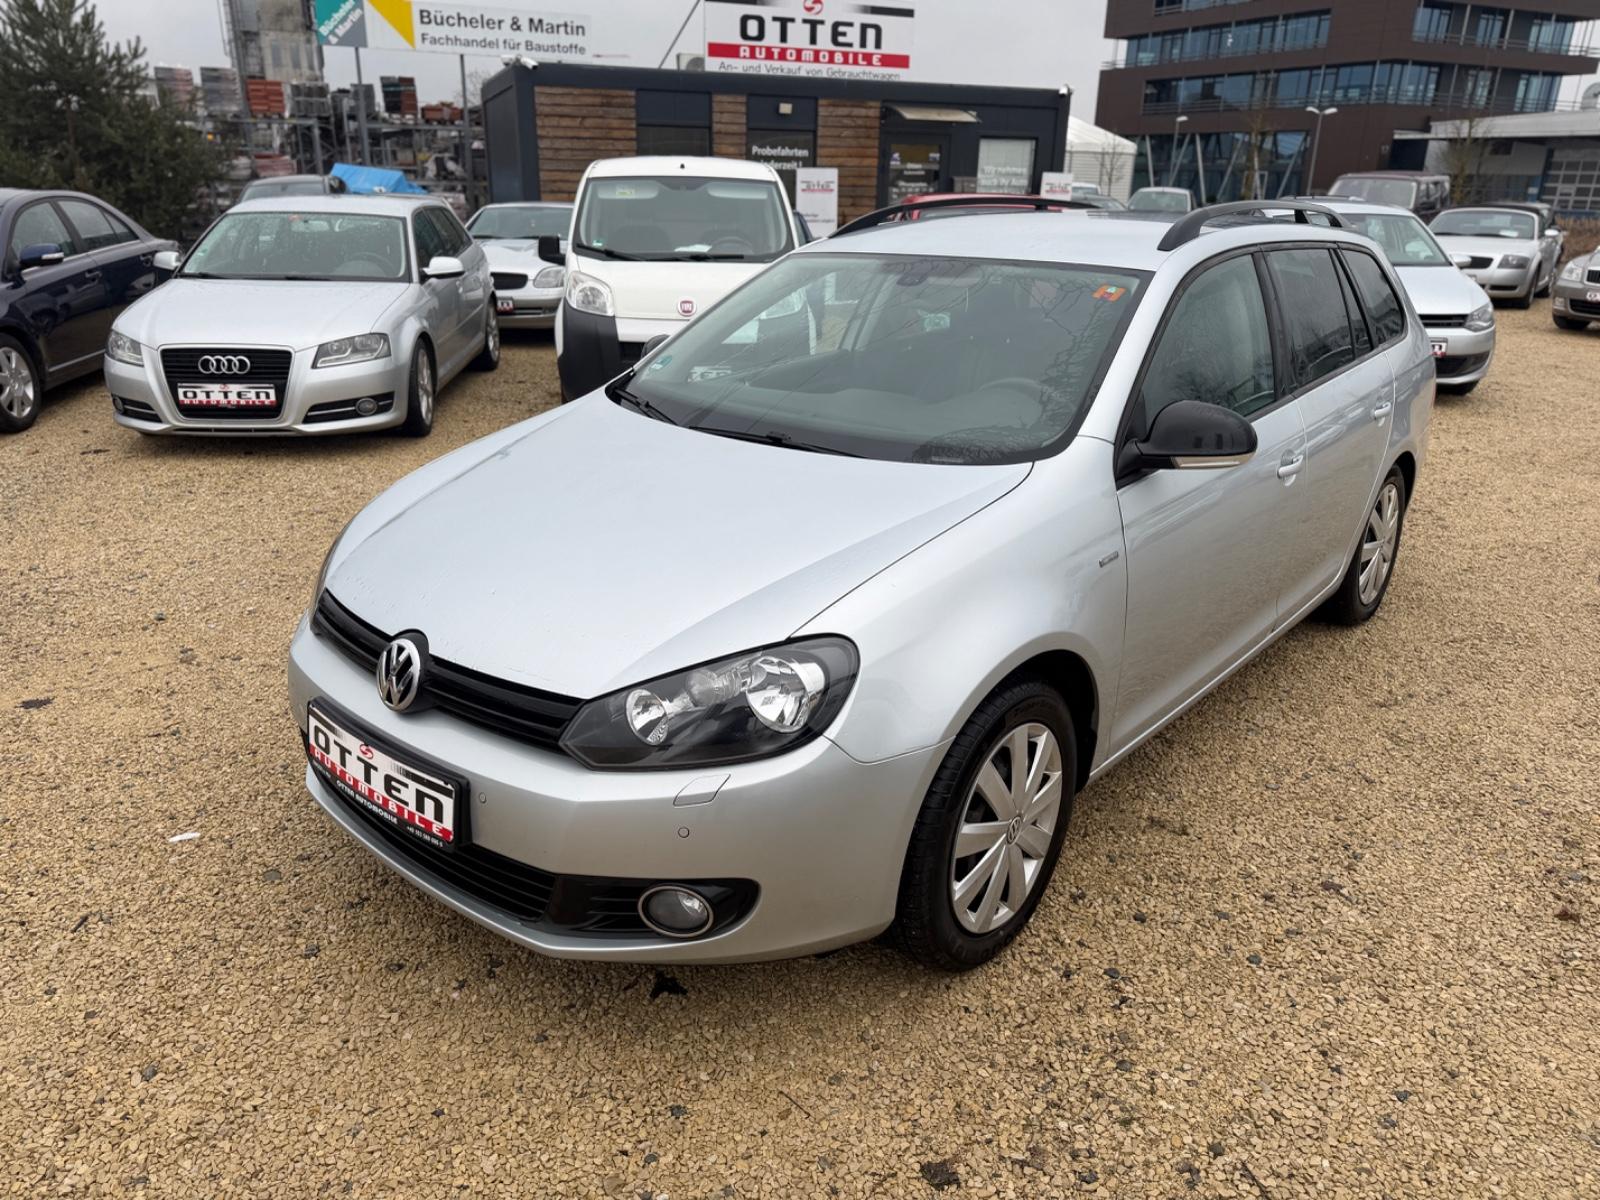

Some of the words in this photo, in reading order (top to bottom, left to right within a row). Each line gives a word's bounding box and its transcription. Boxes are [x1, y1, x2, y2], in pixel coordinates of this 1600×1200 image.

[419, 9, 505, 30] Bücheler
[510, 15, 522, 32] &
[528, 17, 586, 36] Martin
[739, 13, 883, 50] OTTEN
[421, 32, 500, 49] Fachhandel
[503, 38, 522, 51] für
[525, 39, 587, 55] Baustoffe
[739, 46, 883, 66] AUTOMOBILE
[718, 61, 738, 71] An-
[742, 62, 762, 73] und
[765, 63, 802, 75] Verkauf
[805, 68, 824, 76] von
[826, 67, 901, 81] Gebrauchtwagen
[752, 145, 809, 157] Probefahrten
[182, 390, 271, 400] OTTEN
[314, 725, 444, 824] OTTEN
[314, 748, 443, 837] AUTOMOBILE
[336, 781, 356, 799] OTTEN
[355, 791, 399, 825] AUTOMOBILE
